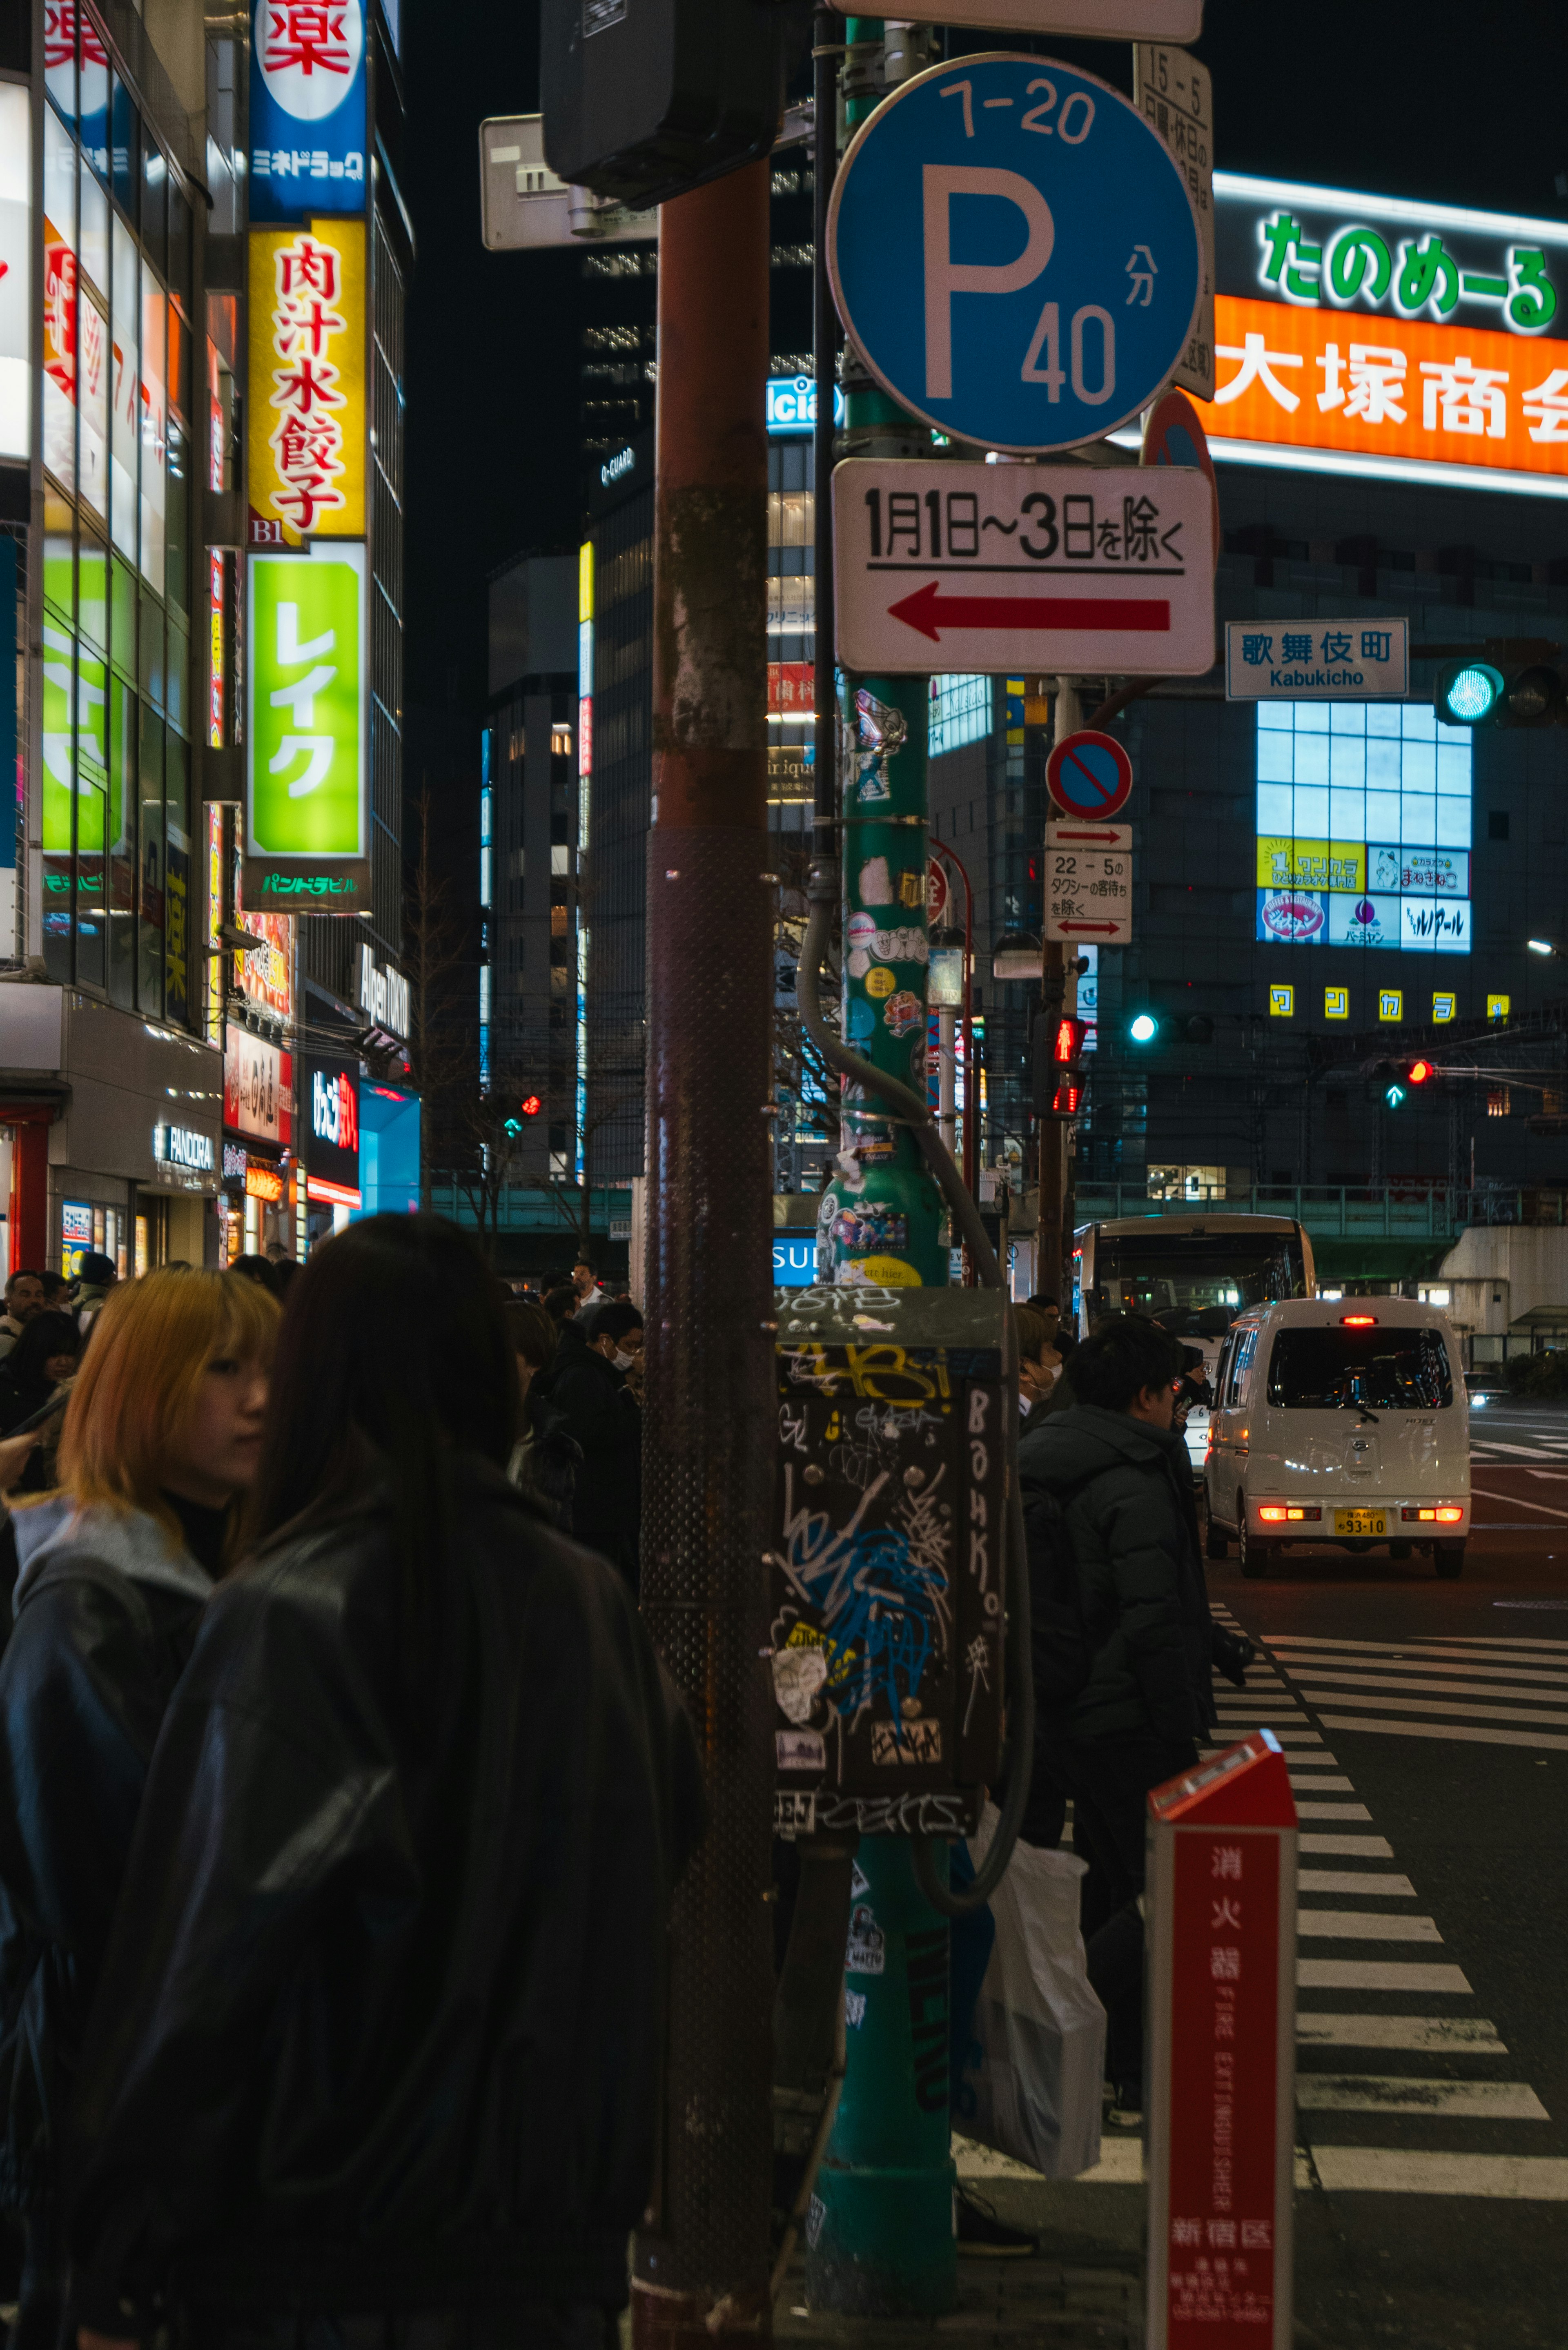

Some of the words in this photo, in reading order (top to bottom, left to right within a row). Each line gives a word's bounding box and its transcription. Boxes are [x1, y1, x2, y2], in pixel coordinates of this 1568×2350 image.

[264, 0, 352, 76] 薬
[940, 78, 1095, 145] 7-20
[253, 149, 363, 180] ミネドラッグ
[922, 163, 1055, 399] P
[1125, 245, 1158, 307] 分
[1262, 212, 1558, 331] たのめーる
[1021, 301, 1116, 405] 40
[274, 239, 342, 530] 肉汁水餃子
[252, 519, 283, 543] B1
[1242, 631, 1392, 665] 歌舞伎町
[1270, 669, 1363, 687] Kabukicho
[269, 602, 337, 798] レイク
[1055, 857, 1076, 875] 22
[1297, 855, 1358, 875] ワンカラ
[1419, 858, 1445, 867] カラオケ
[259, 875, 358, 895] パンドラビル
[1051, 878, 1127, 898] タクシーの客待ち
[1272, 872, 1356, 889] ひとりカラオケ専門店
[1401, 865, 1458, 889] まねきねこ
[1051, 900, 1085, 916] を除く
[1344, 931, 1384, 943] バーミヤン
[170, 1126, 212, 1170] PANDORA
[1346, 1520, 1383, 1533] 93-10
